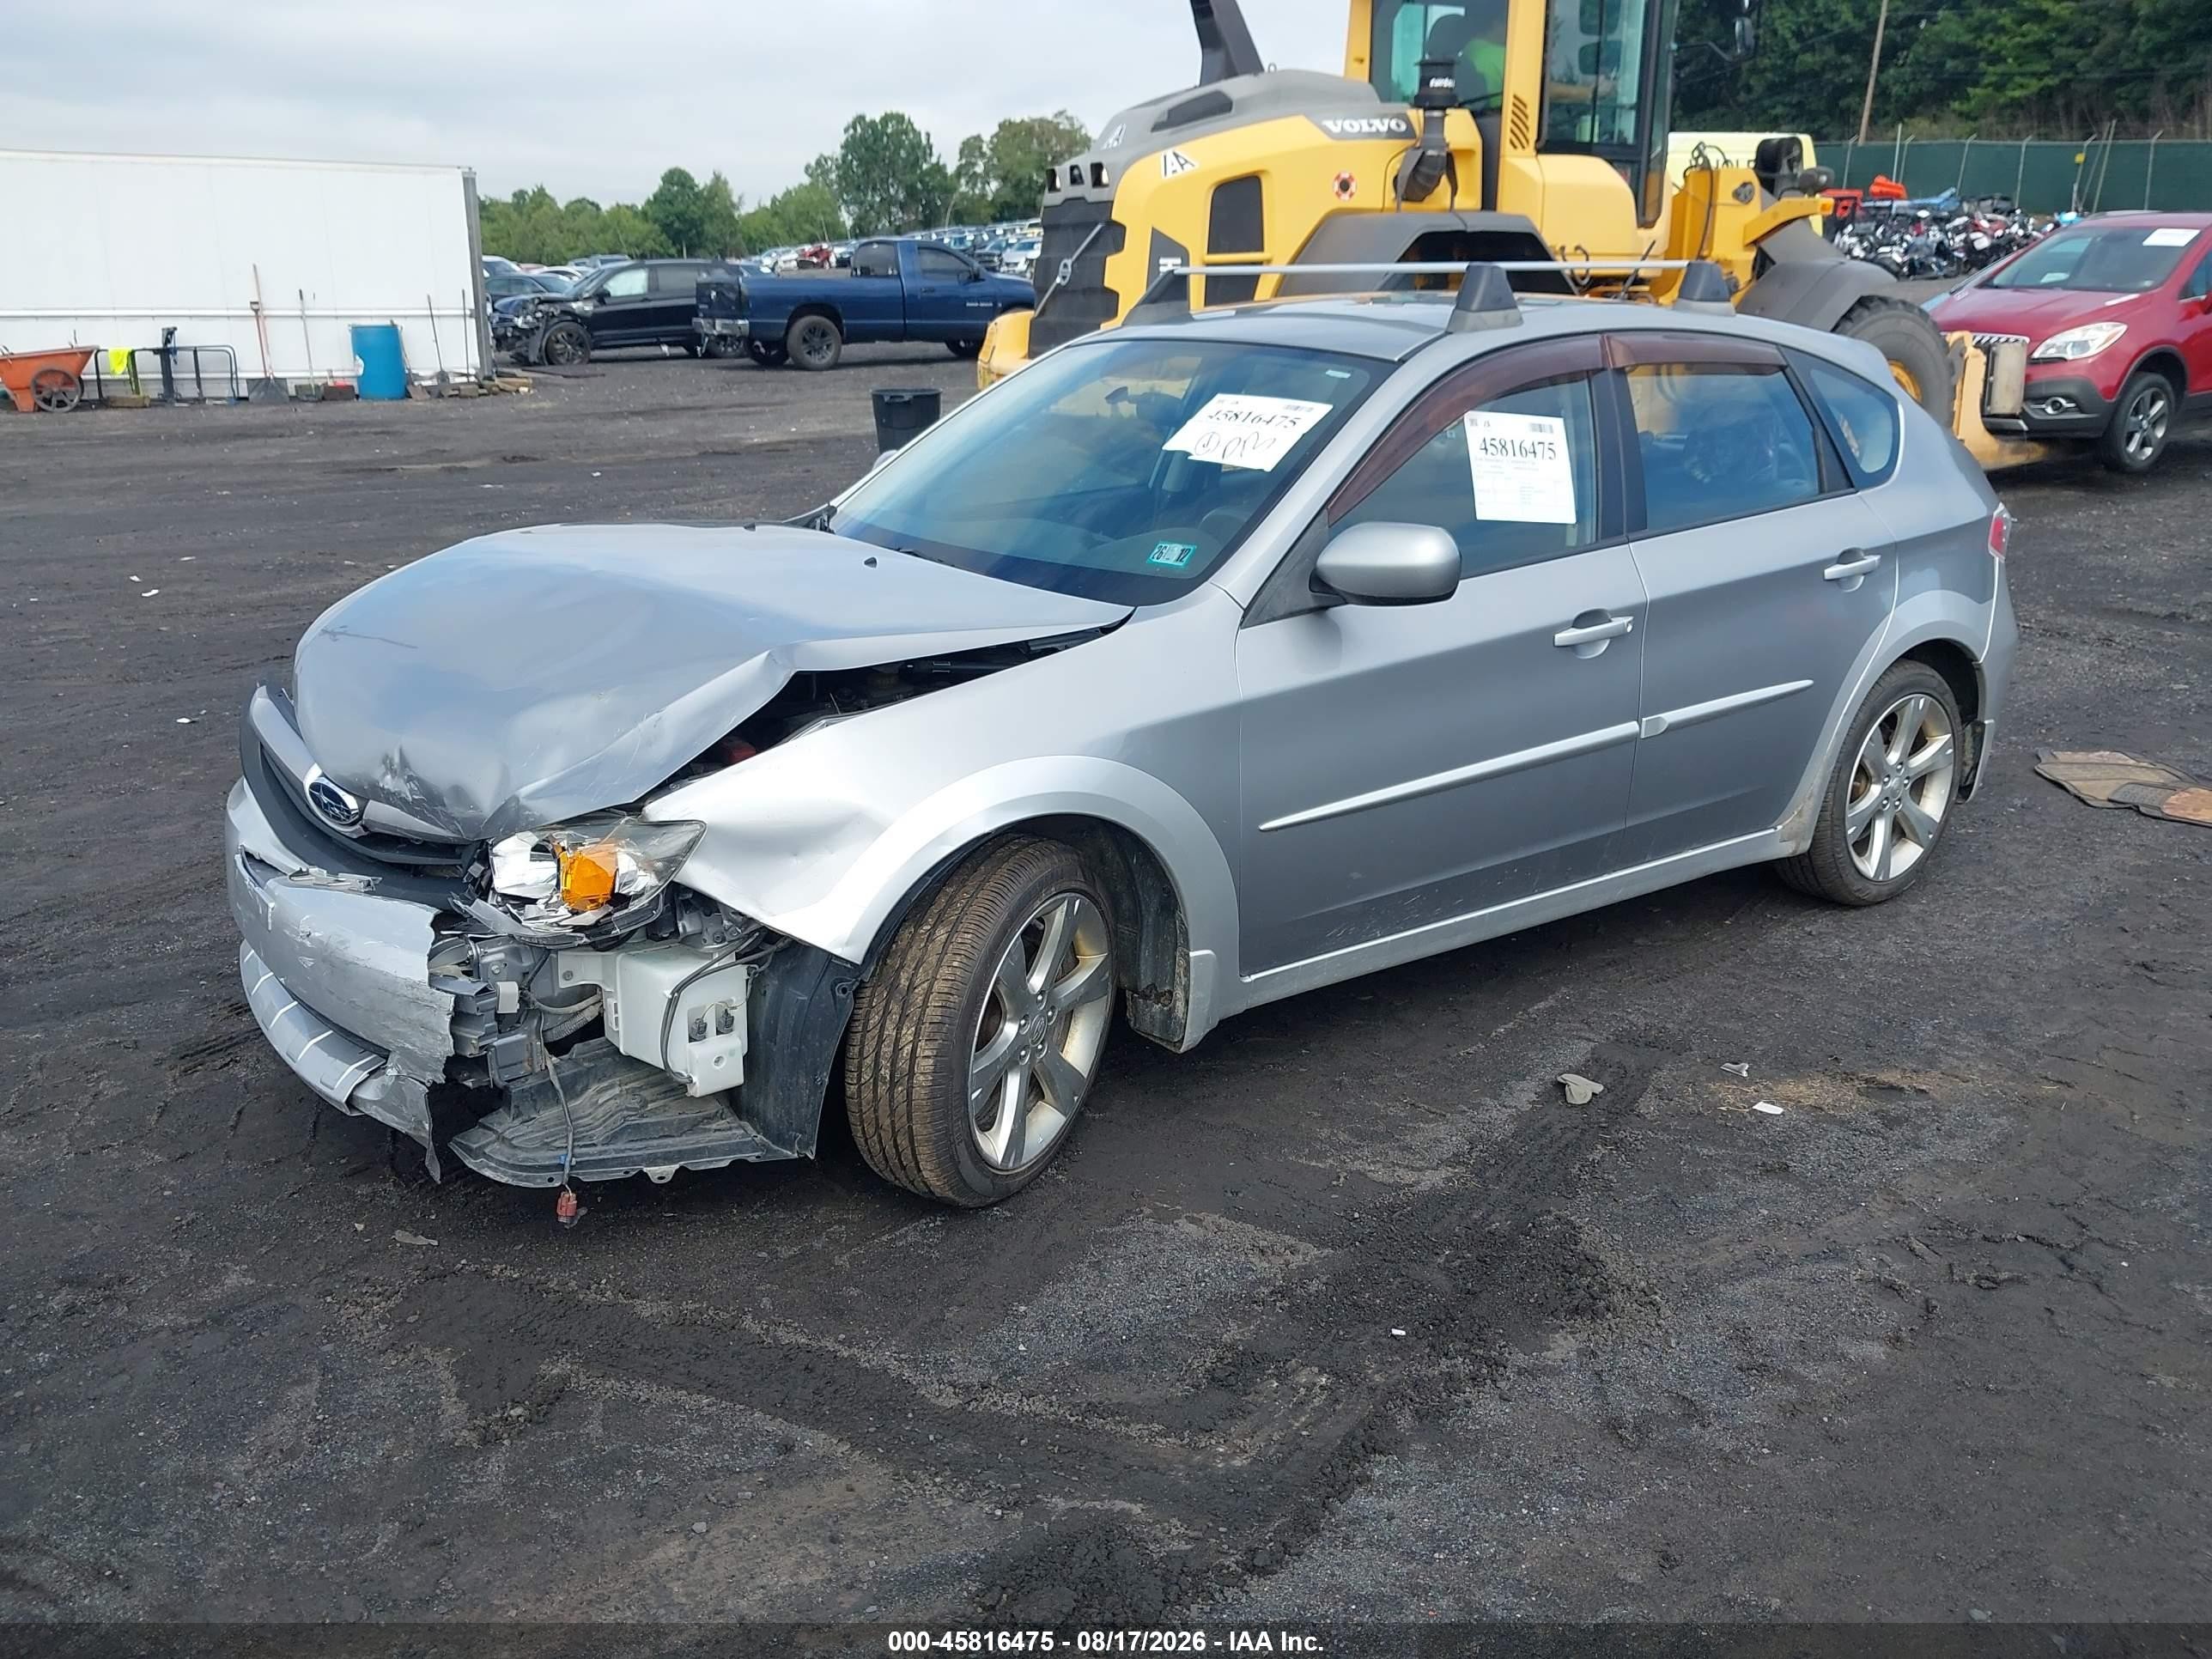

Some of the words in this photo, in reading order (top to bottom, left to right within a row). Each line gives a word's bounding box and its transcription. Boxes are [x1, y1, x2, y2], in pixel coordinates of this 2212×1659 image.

[1322, 117, 1407, 133] VOLVO
[1206, 409, 1302, 429] 45816475
[1479, 436, 1557, 461] 45816475
